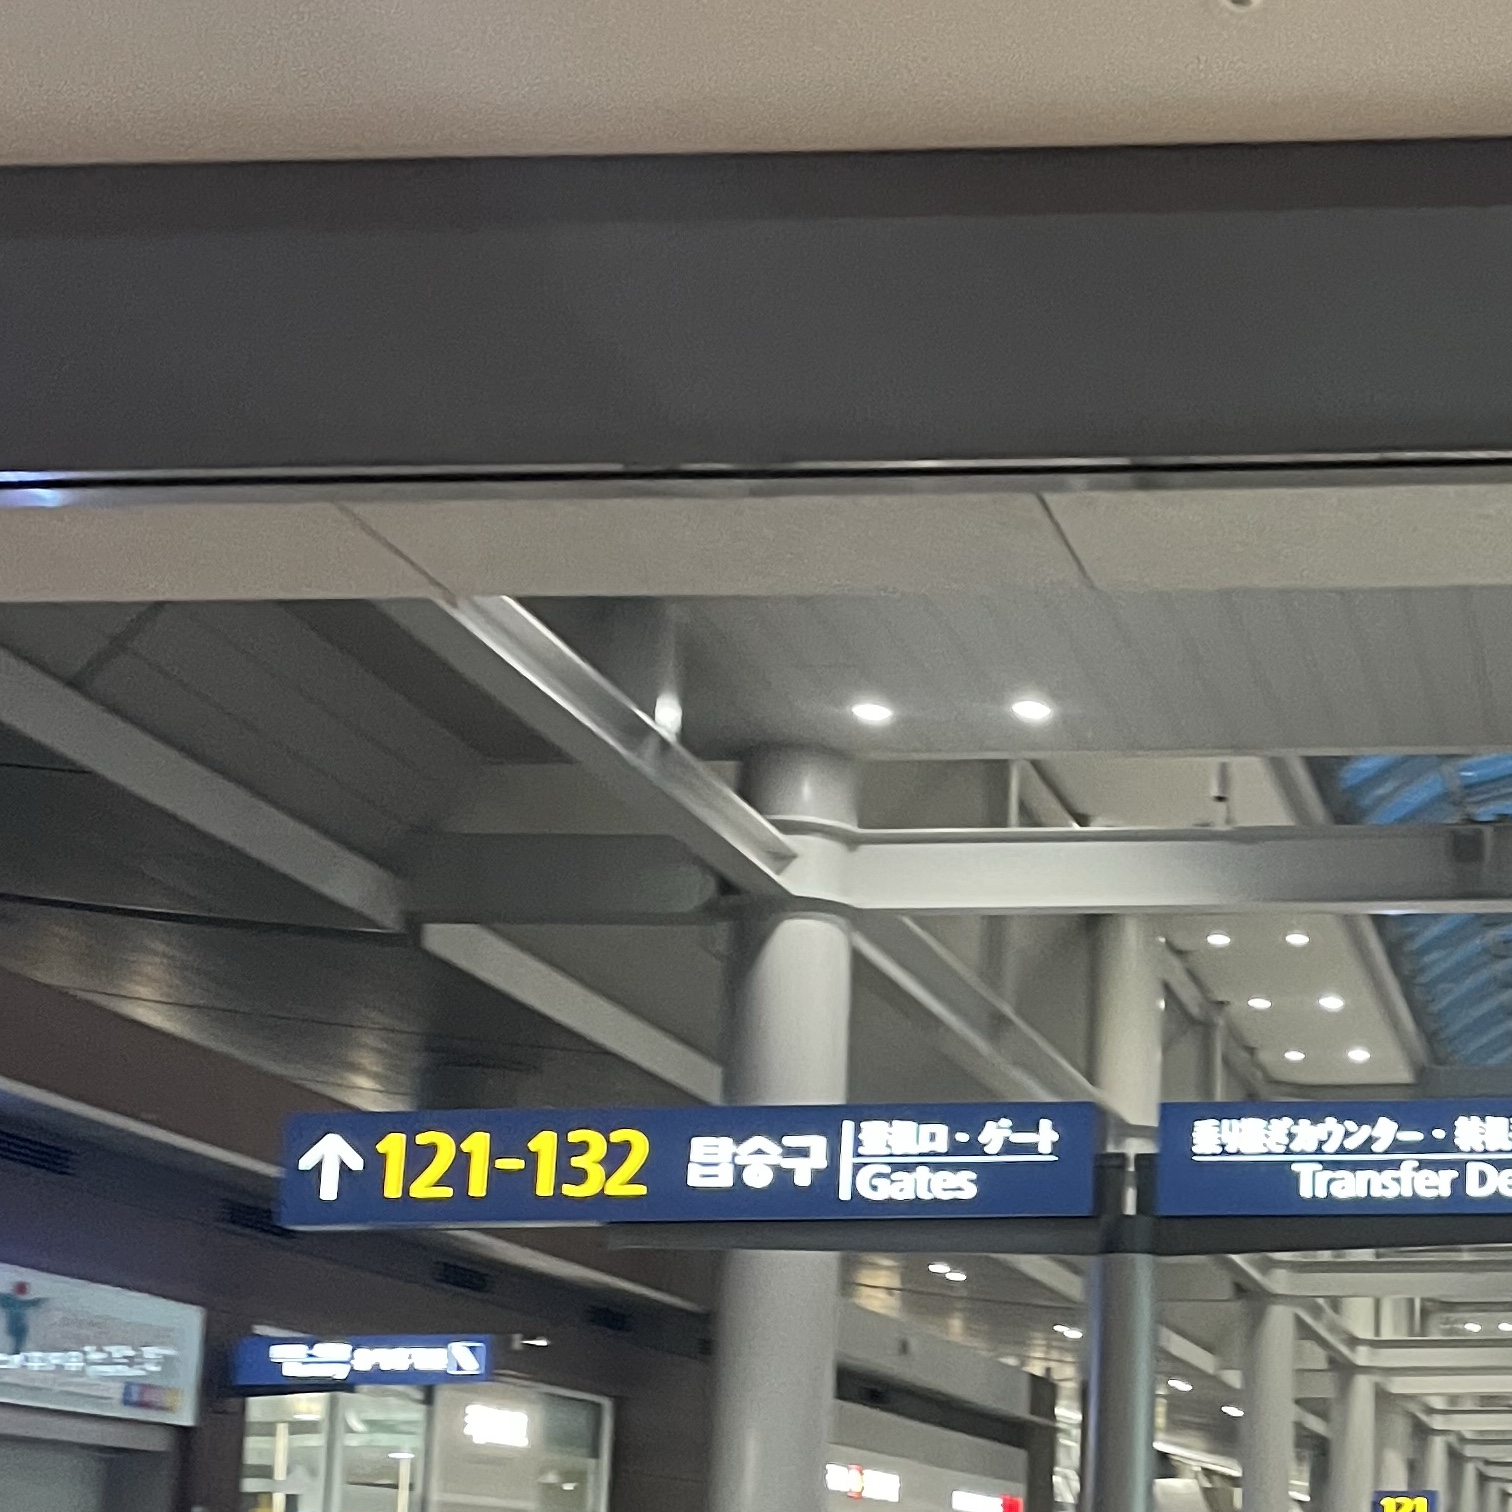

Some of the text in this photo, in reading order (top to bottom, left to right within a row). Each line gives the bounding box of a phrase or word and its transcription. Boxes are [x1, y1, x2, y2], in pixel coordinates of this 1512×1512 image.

[375, 1128, 650, 1199] 121-132
[855, 1163, 978, 1201] Gates
[1291, 1160, 1459, 1199] Transfer
